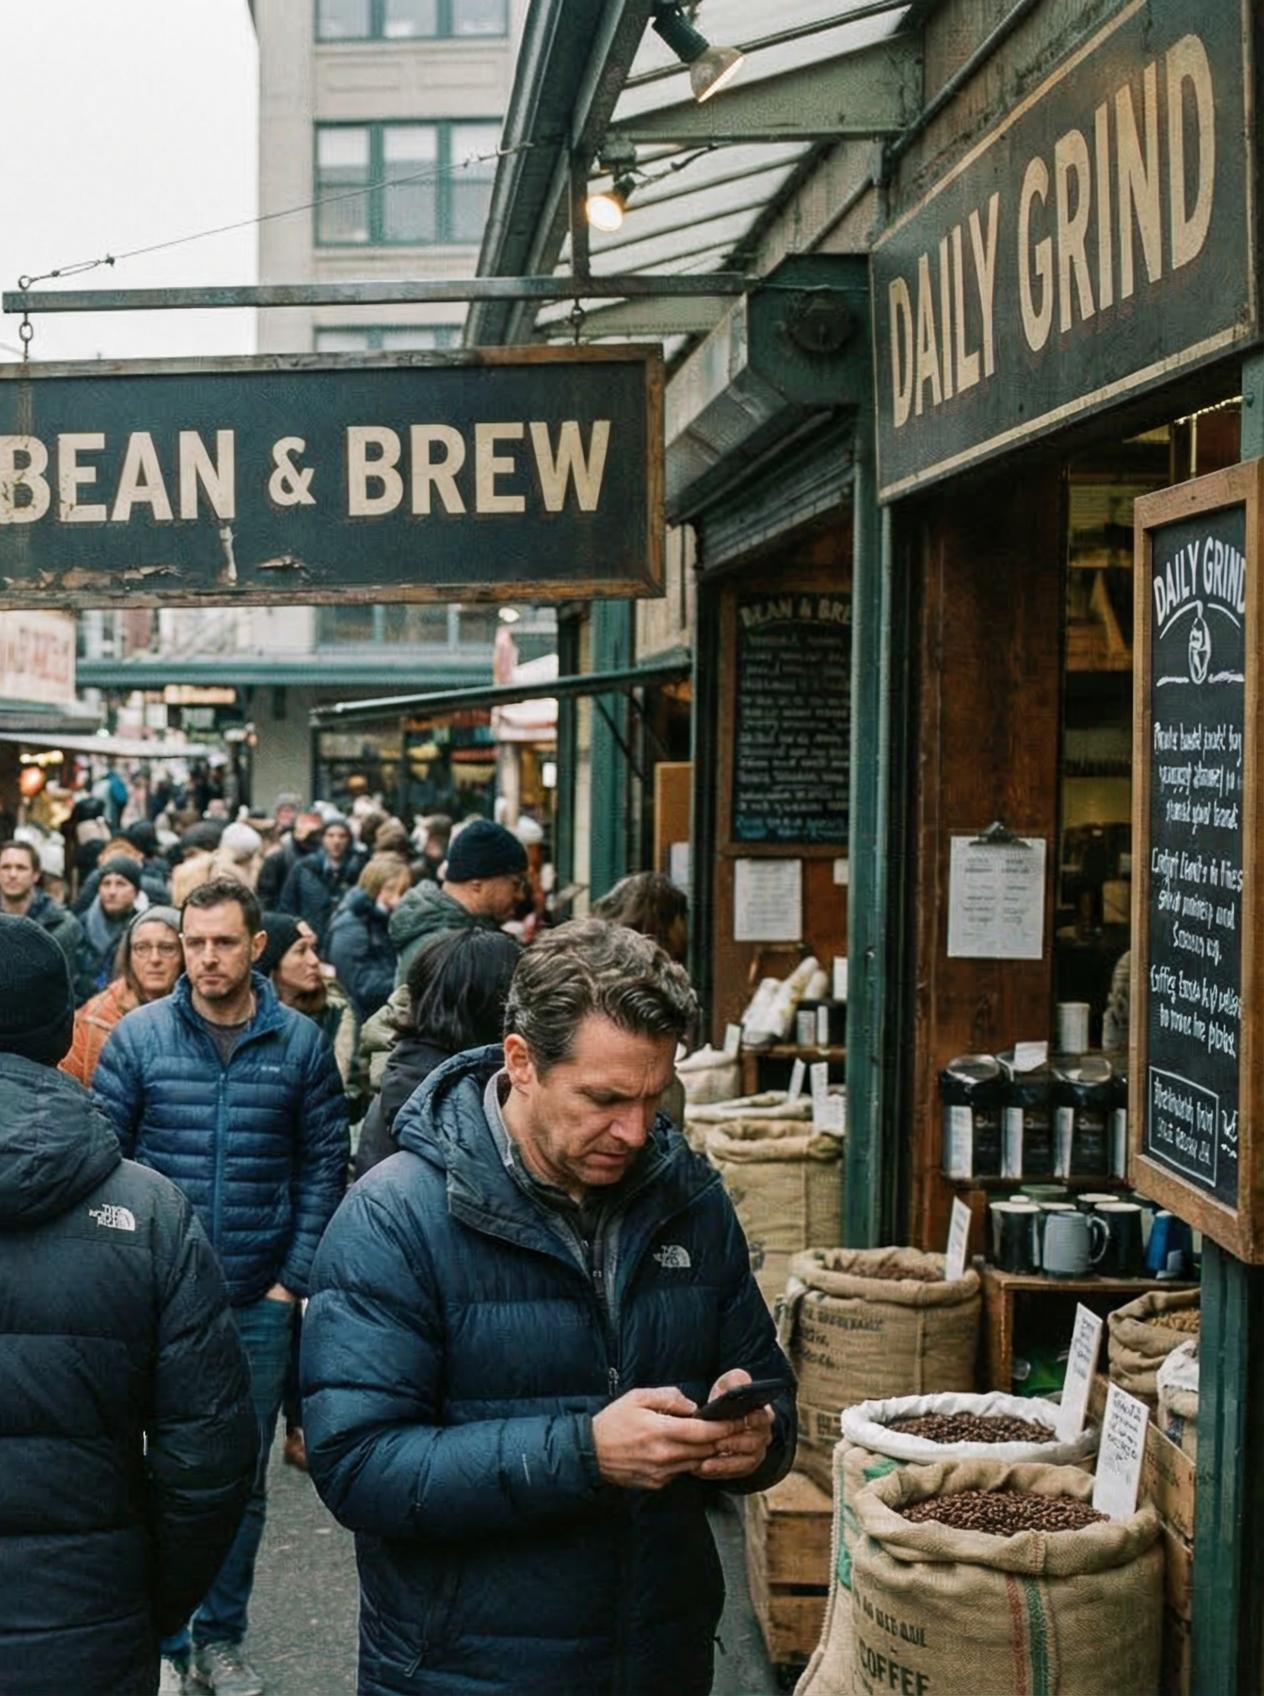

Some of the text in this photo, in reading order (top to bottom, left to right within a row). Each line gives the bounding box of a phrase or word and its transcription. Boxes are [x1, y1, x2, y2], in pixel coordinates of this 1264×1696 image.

[888, 33, 1216, 429] DAILY GRIND
[268, 436, 316, 506] &
[347, 420, 611, 517] BREW
[1153, 536, 1246, 626] DAILY GRIND
[858, 1636, 931, 1696] COFFEE
